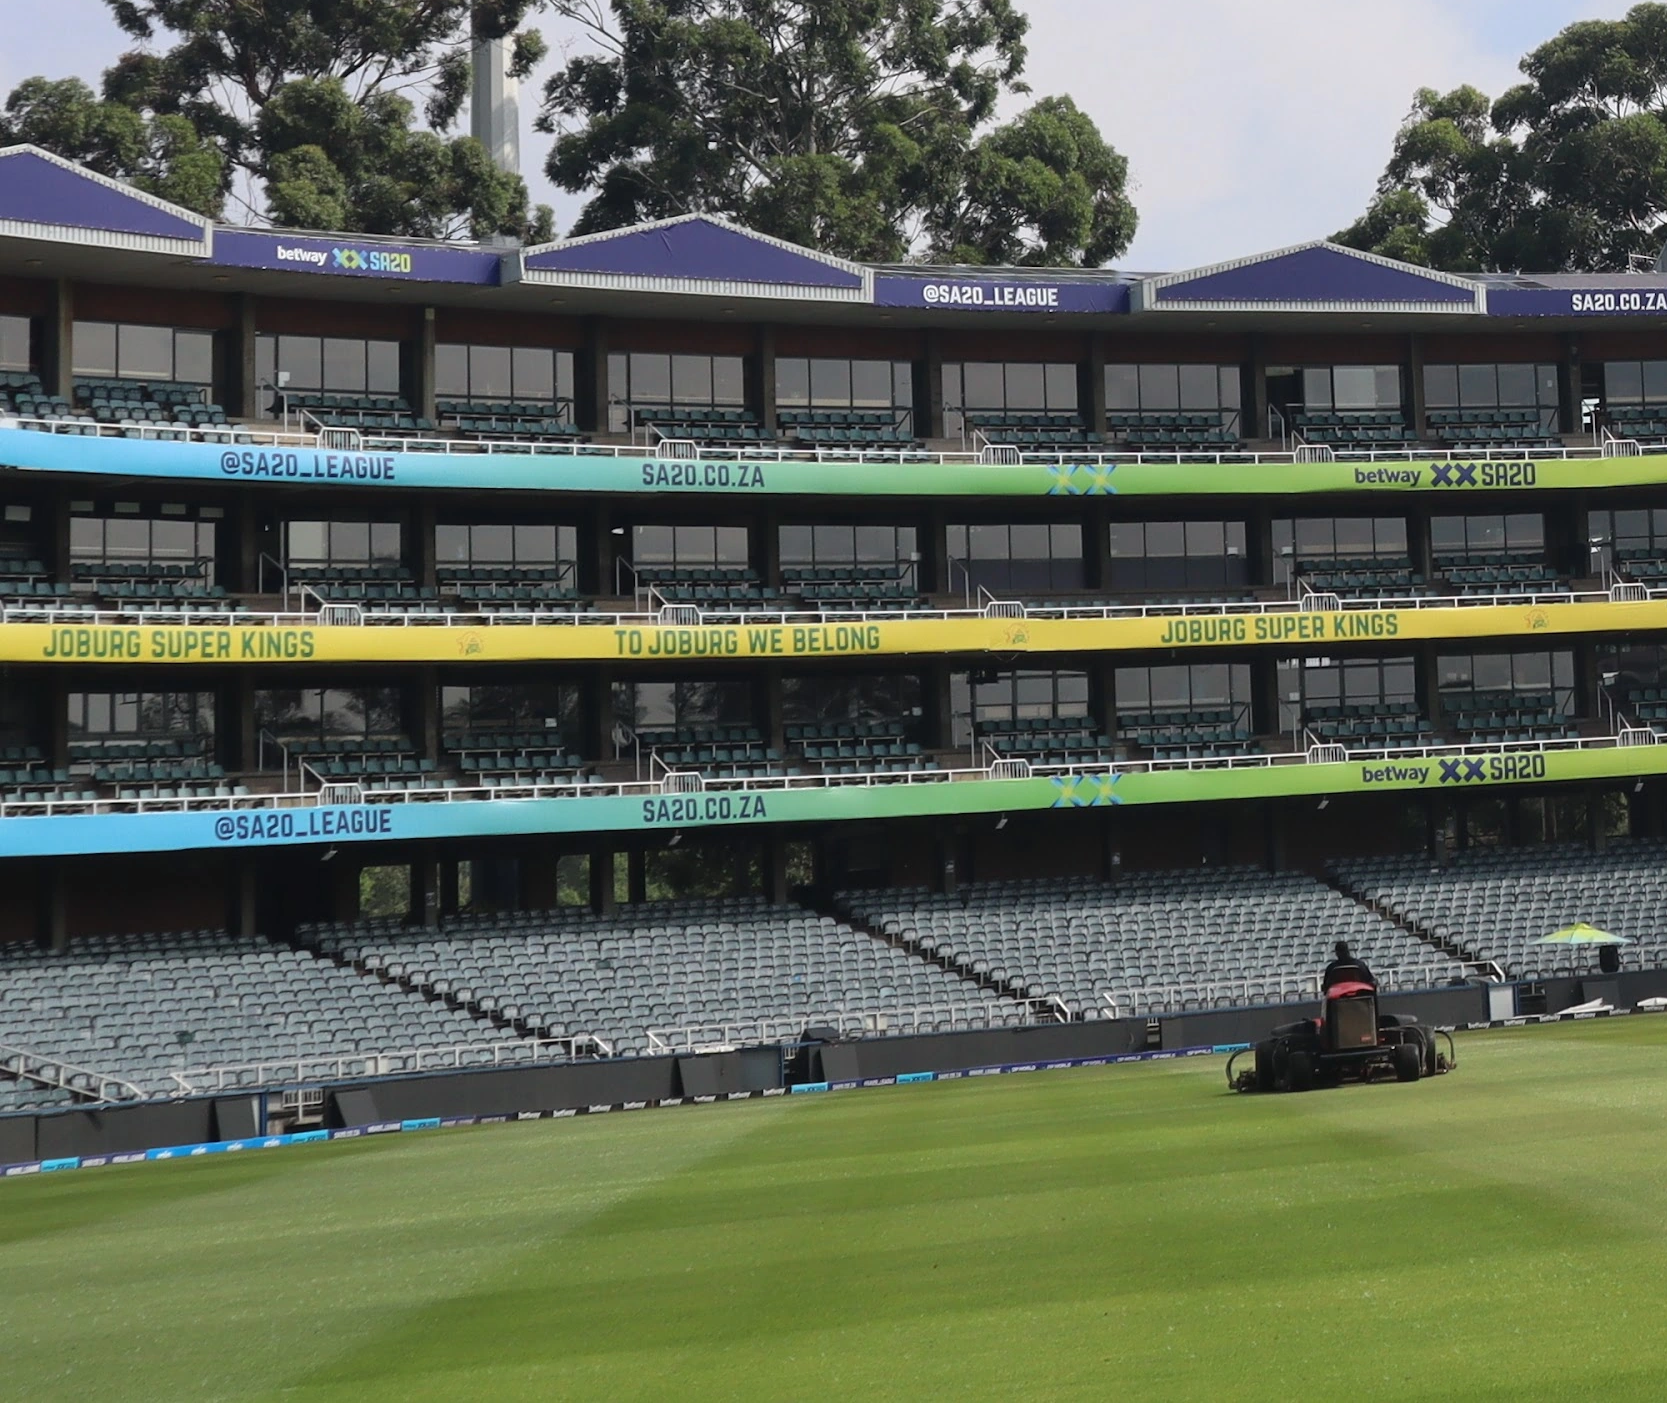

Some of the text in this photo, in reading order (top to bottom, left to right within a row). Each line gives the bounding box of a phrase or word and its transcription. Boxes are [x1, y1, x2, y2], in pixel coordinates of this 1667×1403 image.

[277, 245, 411, 272] betway SA20
[923, 285, 1058, 306] @SA20_LEAGUE
[1572, 293, 1667, 311] SA20.CO.ZA
[221, 452, 395, 480] @SA20_LEAGUE
[643, 464, 765, 488] SA20.CO.ZA
[1355, 463, 1536, 488] betway SA20
[614, 626, 880, 656] TO JOBURG WE BELONG
[1161, 613, 1398, 643] JOBURG SUPER KINGS
[43, 629, 314, 658] JOBURG SUPER KINGS
[1362, 754, 1545, 784] betway SA20
[643, 795, 767, 822] SA20.CO.ZA
[215, 809, 392, 841] @SA20_LEAGUE
